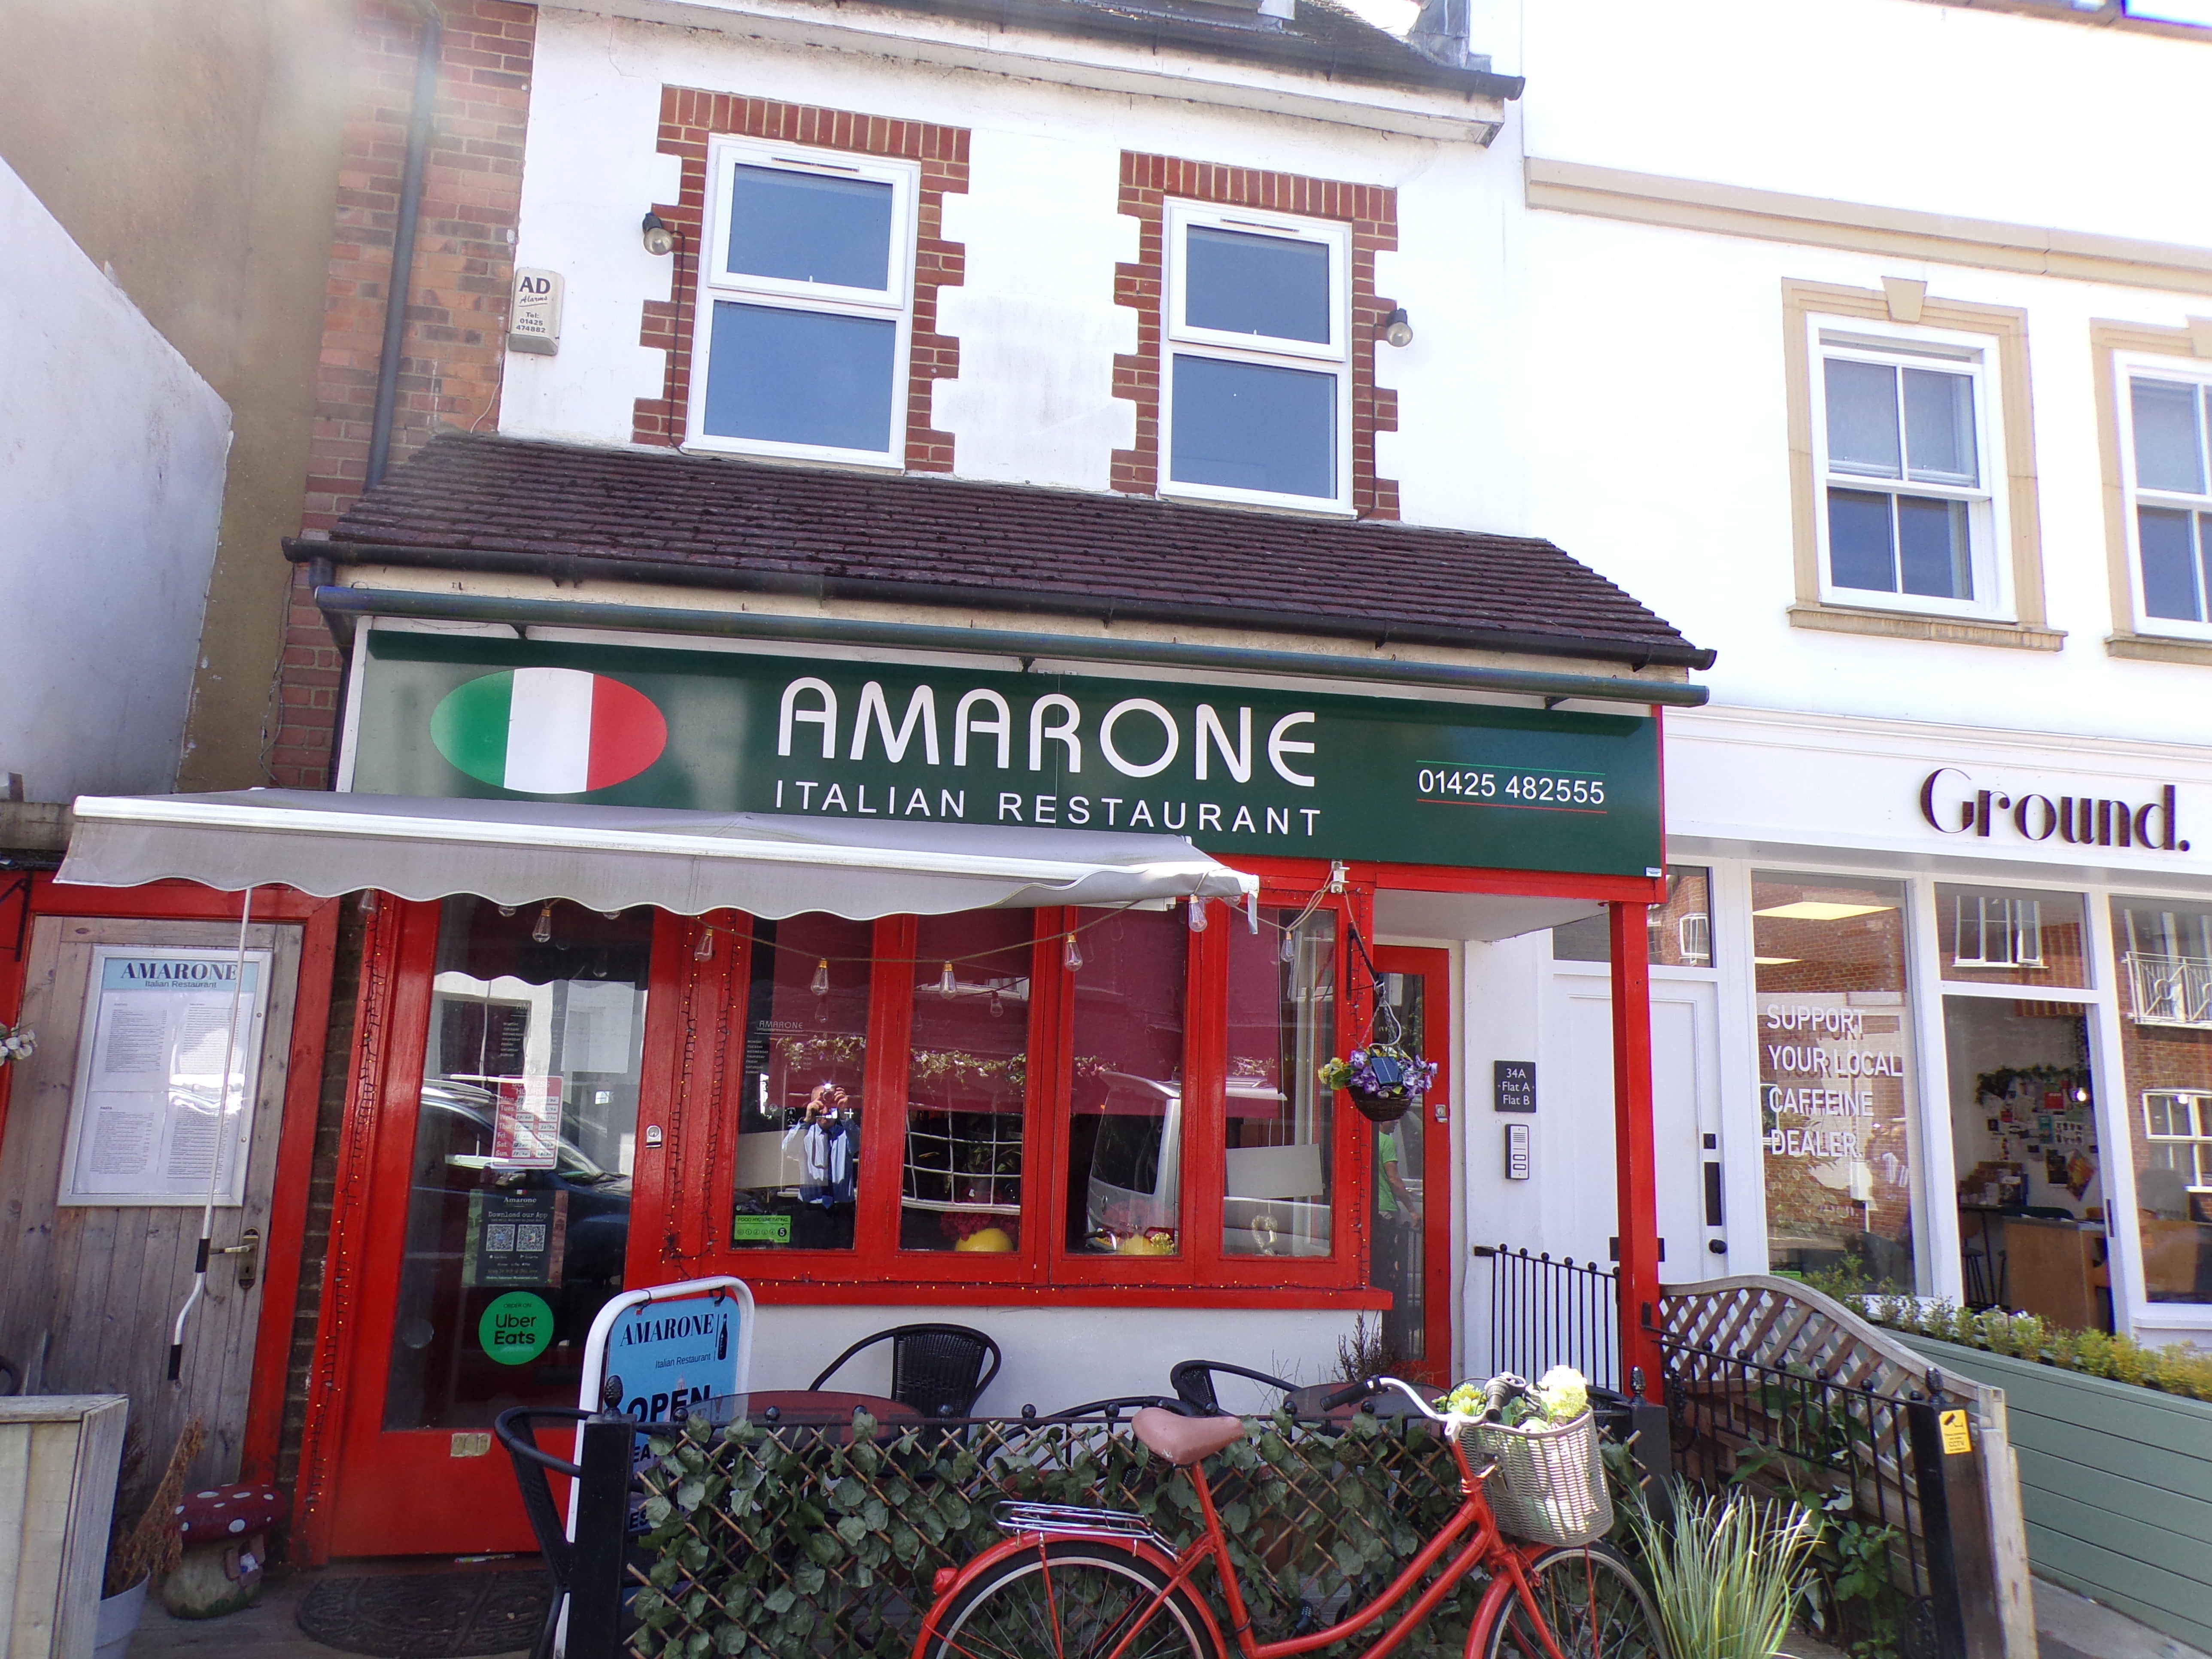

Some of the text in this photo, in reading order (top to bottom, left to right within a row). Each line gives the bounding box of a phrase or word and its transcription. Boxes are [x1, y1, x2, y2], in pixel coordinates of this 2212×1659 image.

[519, 276, 551, 294] AD
[520, 295, 547, 304] Alarms
[516, 325, 546, 333] 474882
[778, 677, 1315, 787] AMARONE
[1418, 769, 1604, 805] 01425 482555
[776, 780, 1321, 836] ITALIAN RESTAURANT
[1920, 767, 2190, 852] Ground.
[120, 963, 238, 980] AMARONE
[759, 1020, 803, 1029] AMARONE
[1766, 1003, 1866, 1034] SUPPORT
[1768, 1045, 1903, 1077] YOUR LOCAL
[1506, 1068, 1526, 1079] 34A
[1502, 1081, 1531, 1092] Flat A
[1503, 1094, 1530, 1105] Flat B
[1768, 1087, 1875, 1117] CAFFEINE
[495, 1313, 537, 1328] Uber
[494, 1331, 536, 1345] Eats
[620, 1313, 714, 1347] AMARONE
[655, 1352, 711, 1369] Italian Restaurant
[627, 1385, 711, 1422] OPEN
